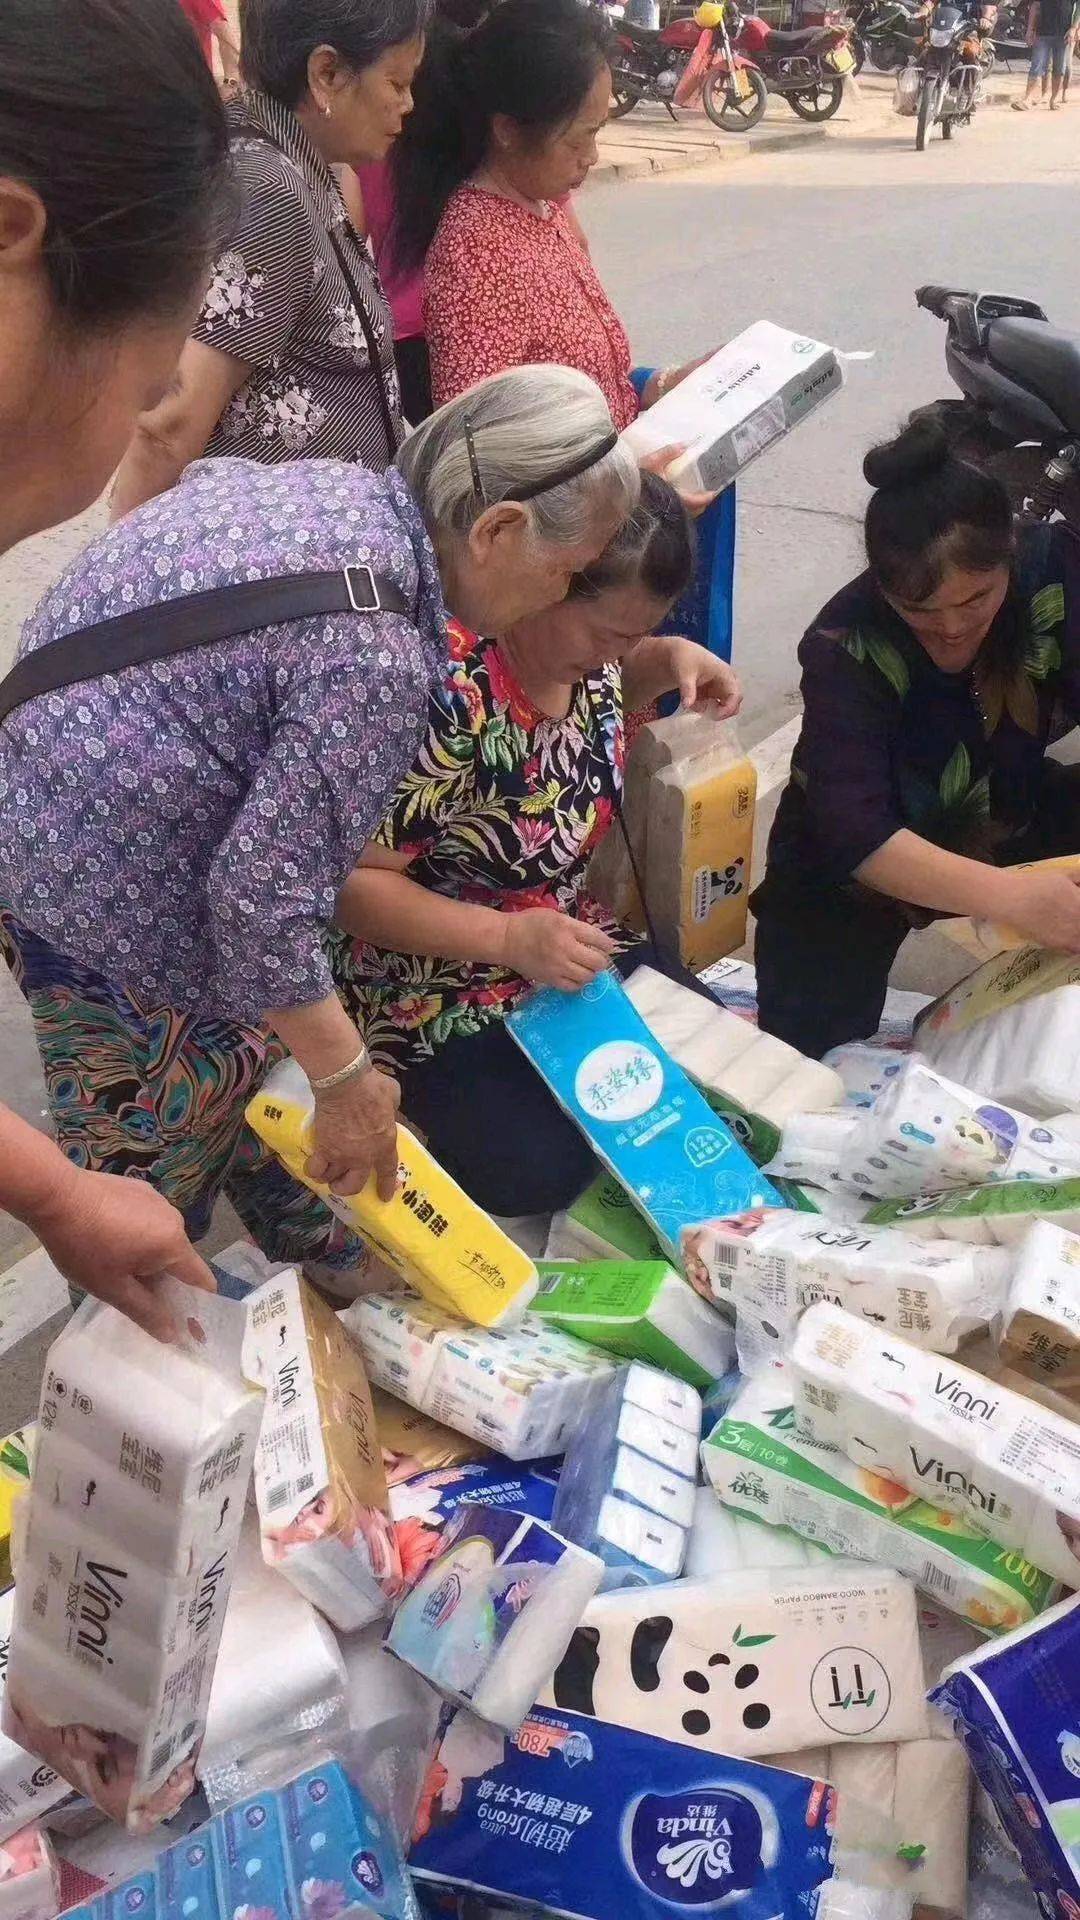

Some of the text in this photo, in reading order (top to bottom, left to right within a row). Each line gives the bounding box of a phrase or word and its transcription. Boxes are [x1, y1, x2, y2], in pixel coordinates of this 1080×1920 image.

[402, 1189, 449, 1238] 小淘熊
[1030, 1331, 1070, 1356] 维尼
[279, 1356, 301, 1407] Vinni
[934, 1371, 1000, 1420] Vinni
[949, 1405, 976, 1424] TISSUE
[119, 1431, 140, 1480] 宝宝
[141, 1443, 164, 1495] 维尼
[909, 1446, 997, 1514] Vinni
[64, 1582, 79, 1623] TISSUE
[78, 1560, 128, 1665] Vinni
[195, 1550, 228, 1632] Vinni
[476, 1779, 593, 1827] 4层超韧大升级
[656, 1816, 734, 1839] Vinda
[687, 1805, 718, 1817] 维达
[477, 1802, 576, 1854] 超韧 Strong
[479, 1819, 507, 1839] Ultra
